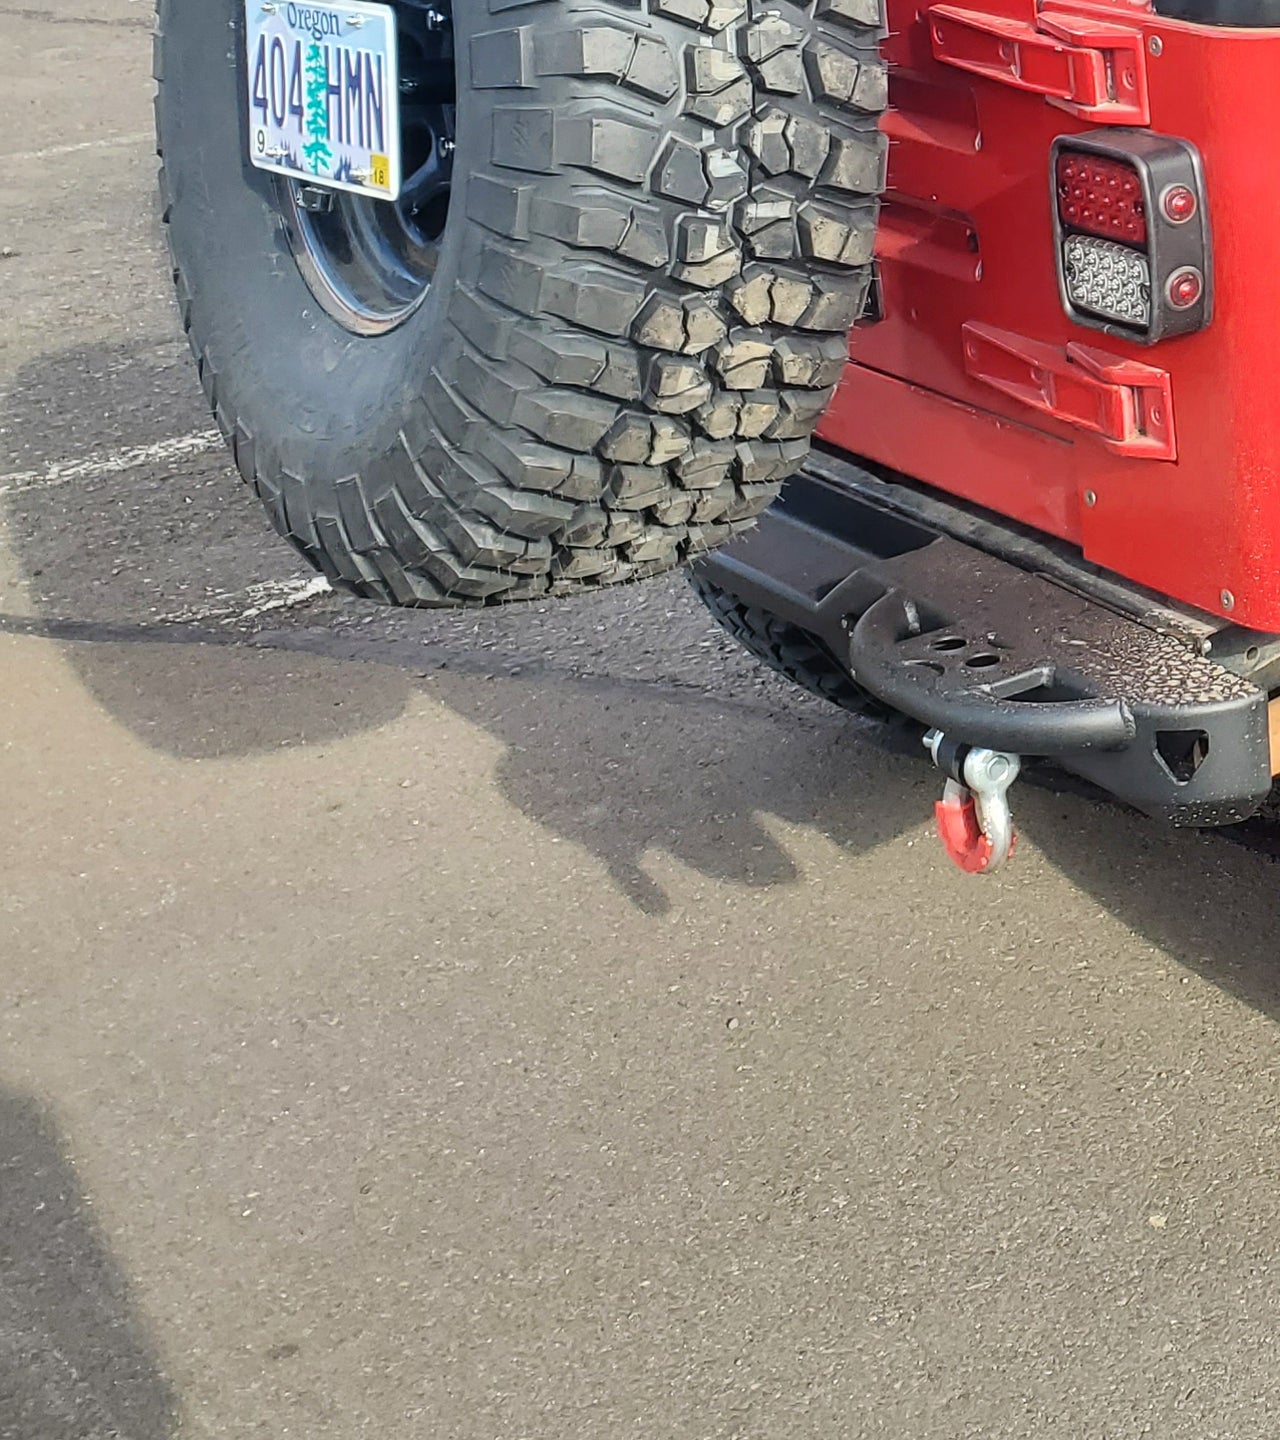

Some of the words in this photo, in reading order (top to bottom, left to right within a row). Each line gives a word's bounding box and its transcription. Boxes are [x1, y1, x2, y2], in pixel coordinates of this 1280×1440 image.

[287, 1, 341, 41] Oregon
[252, 33, 304, 135] 404
[323, 44, 385, 153] HMN
[256, 129, 266, 154] 9
[373, 166, 385, 186] 18
